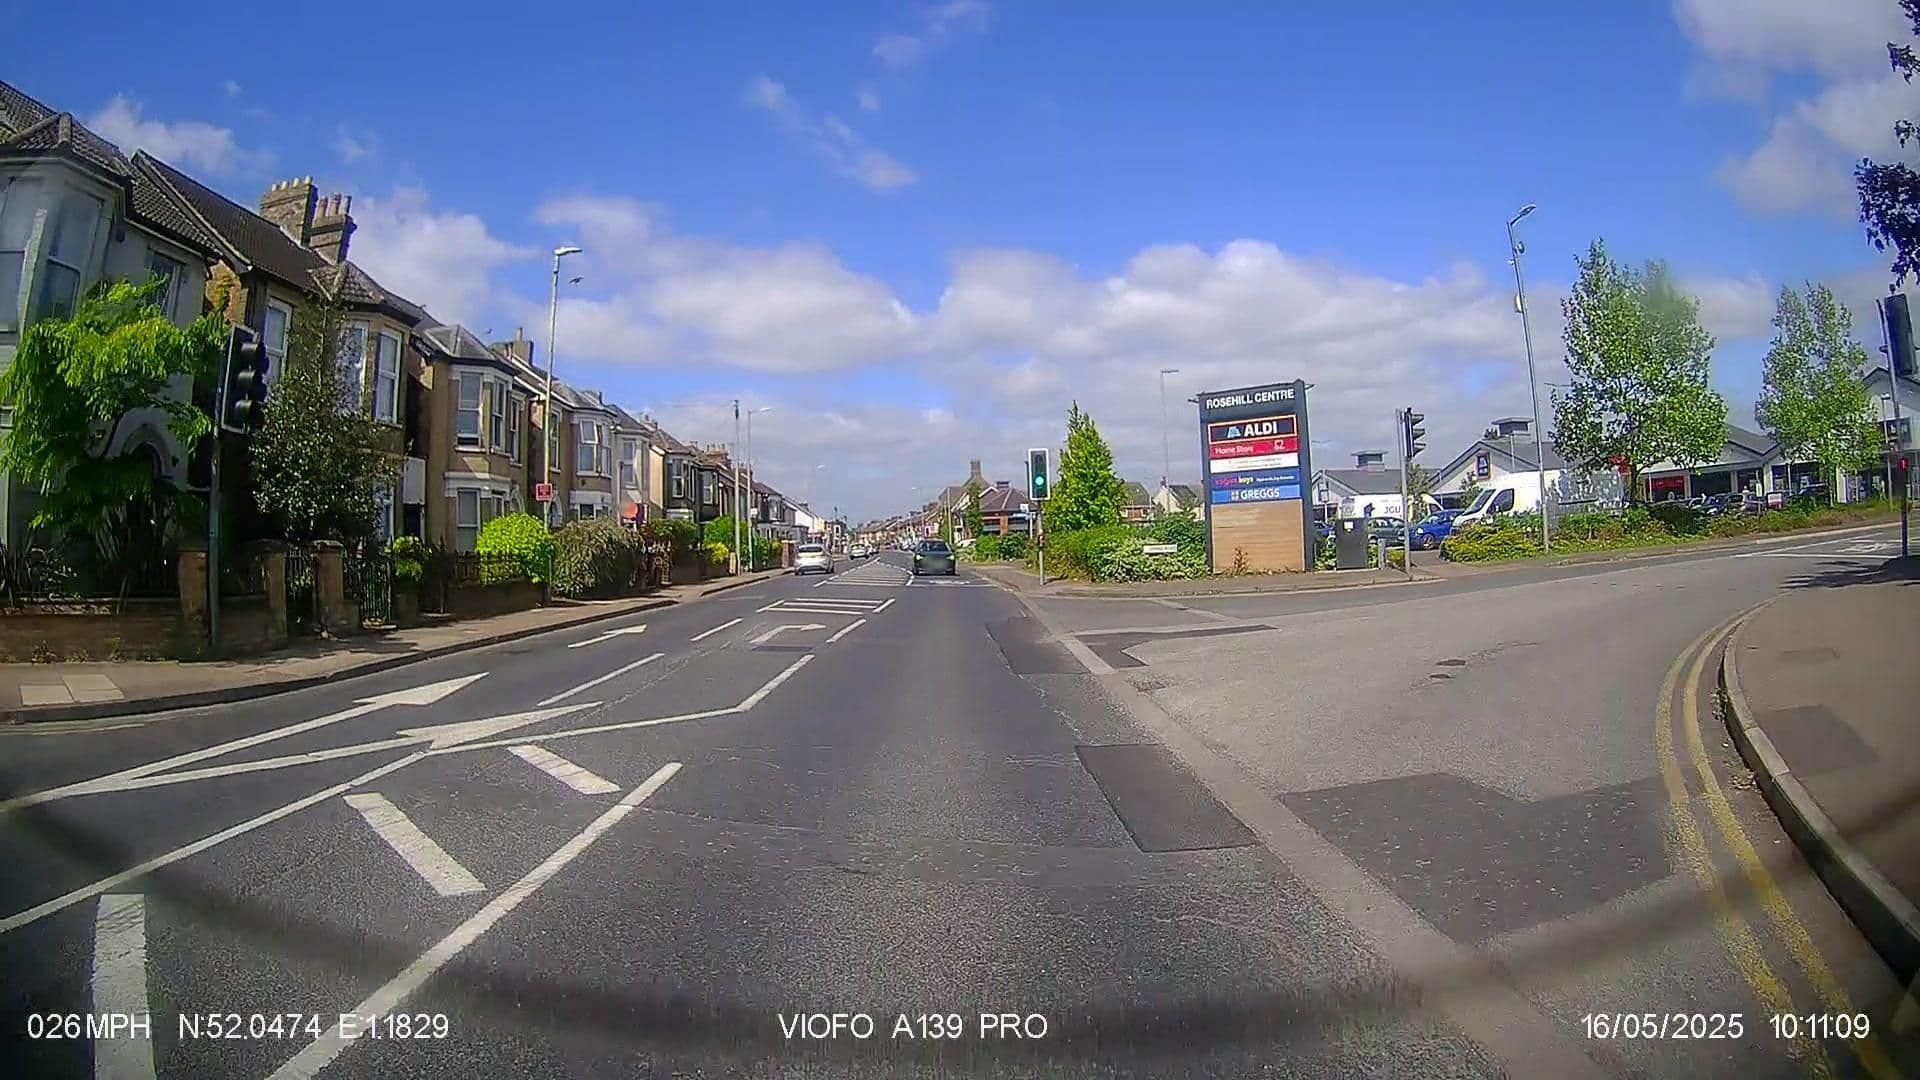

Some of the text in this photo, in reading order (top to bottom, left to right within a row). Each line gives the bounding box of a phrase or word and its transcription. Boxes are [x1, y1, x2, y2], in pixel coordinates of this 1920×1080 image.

[1206, 388, 1295, 409] ROSEHILL CENTRE
[1243, 421, 1278, 437] ALDI
[1241, 488, 1280, 499] GREGGS
